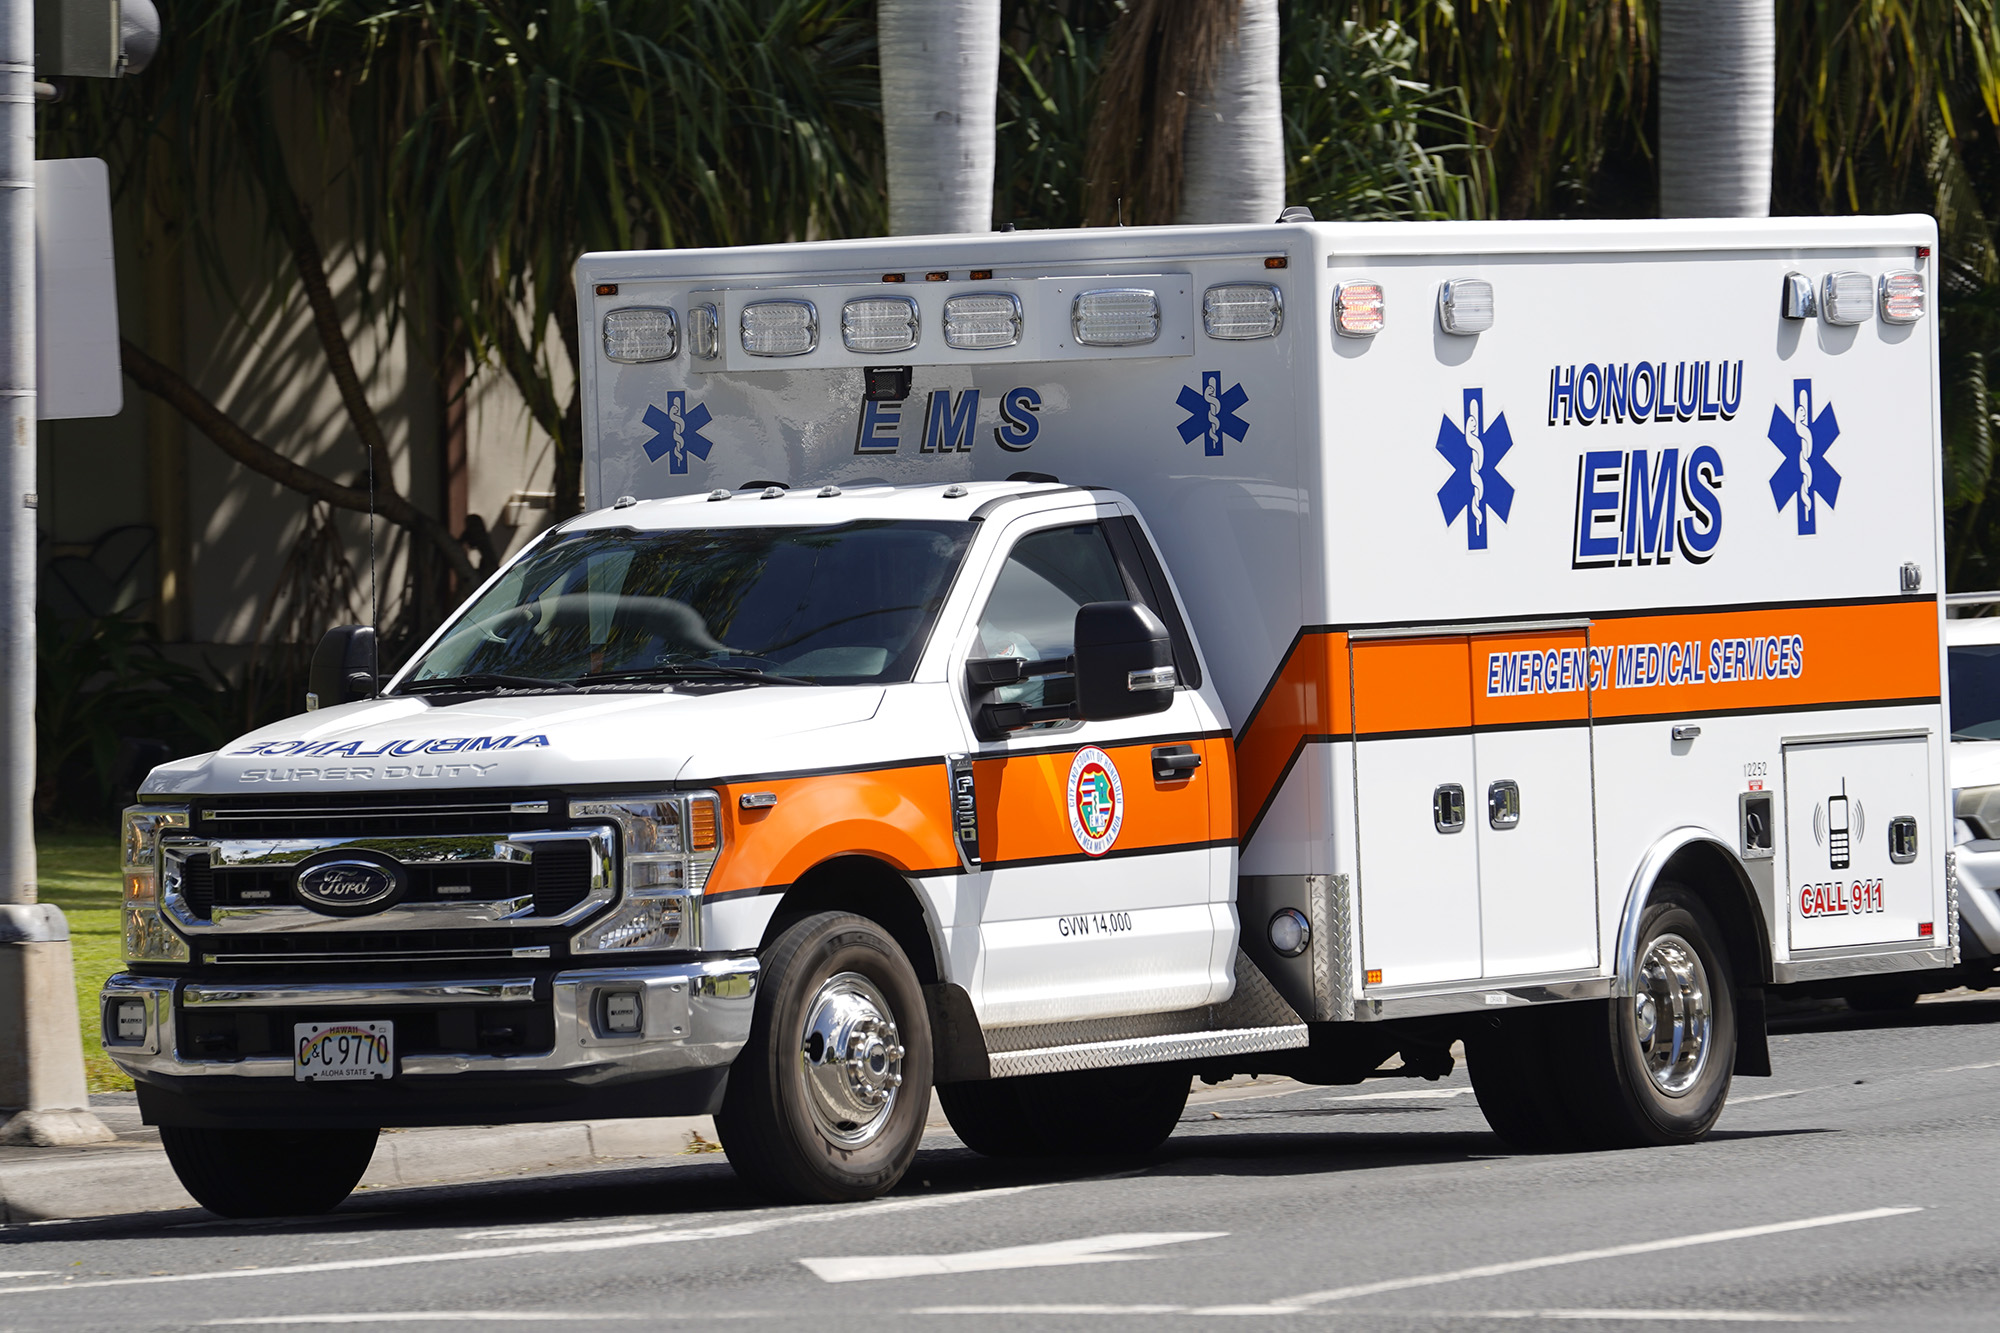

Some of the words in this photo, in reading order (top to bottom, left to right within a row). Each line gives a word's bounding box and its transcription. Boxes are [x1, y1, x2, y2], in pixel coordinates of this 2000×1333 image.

[1548, 360, 1743, 426] HONOLULU
[854, 385, 1043, 455] EMS
[1572, 445, 1724, 570] EMS
[1486, 646, 1614, 697] EMERGENCY
[1615, 641, 1705, 689] MEDICAL
[1709, 634, 1803, 683] SERVICES
[239, 766, 376, 783] SUPER
[381, 763, 498, 779] DUTY
[1071, 766, 1079, 784] AND
[1078, 750, 1095, 768] COUNTY
[1097, 751, 1103, 763] OF
[1104, 759, 1122, 804] HONOLULU
[1744, 761, 1767, 777] 12252
[1090, 815, 1104, 827] EMS
[1111, 815, 1121, 832] MUA
[318, 870, 370, 896] Ford
[1800, 884, 1849, 918] CALL
[1851, 878, 1884, 914] 911
[1058, 916, 1089, 937] GVW
[1093, 912, 1132, 936] 14,000
[329, 1026, 358, 1034] HAWAII
[321, 1069, 344, 1077] ALOHA
[346, 1068, 367, 1076] STATE
